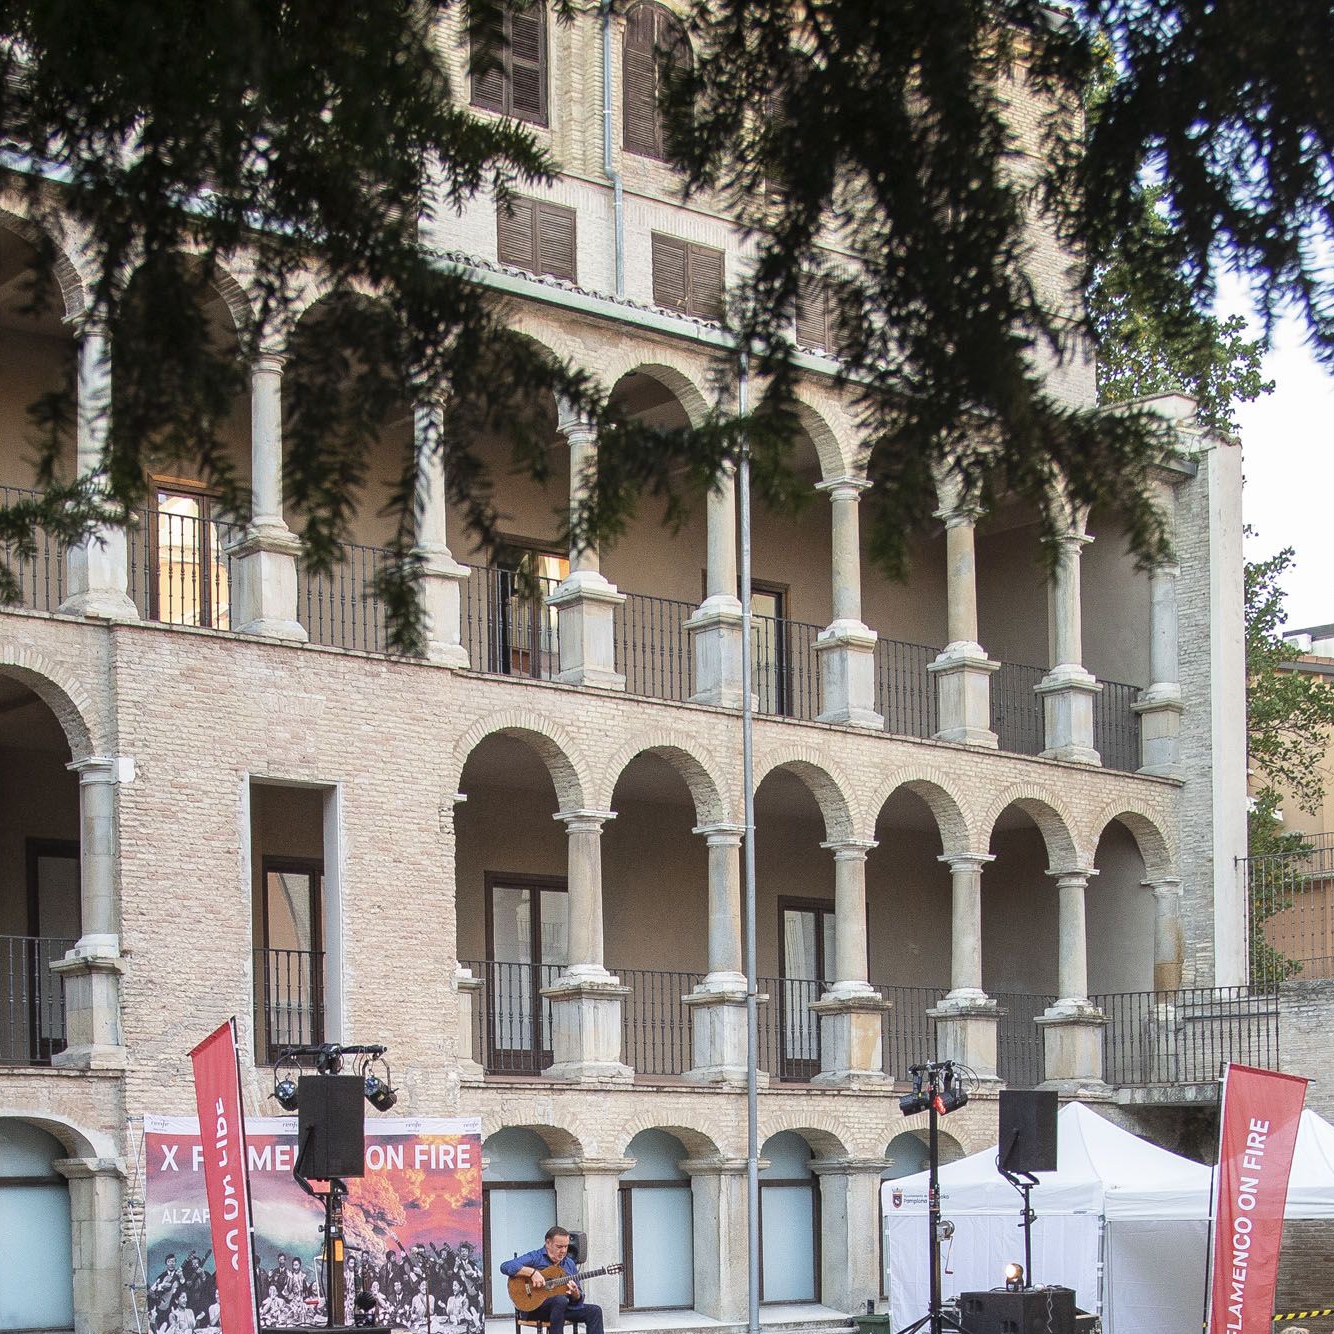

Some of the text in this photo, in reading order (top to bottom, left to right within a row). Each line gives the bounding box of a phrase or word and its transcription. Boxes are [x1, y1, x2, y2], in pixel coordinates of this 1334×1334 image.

[160, 1144, 179, 1171] X
[366, 1144, 404, 1170] ON
[414, 1144, 471, 1170] FIRE
[1243, 1118, 1270, 1171] FIRE
[1237, 1176, 1259, 1211] ON
